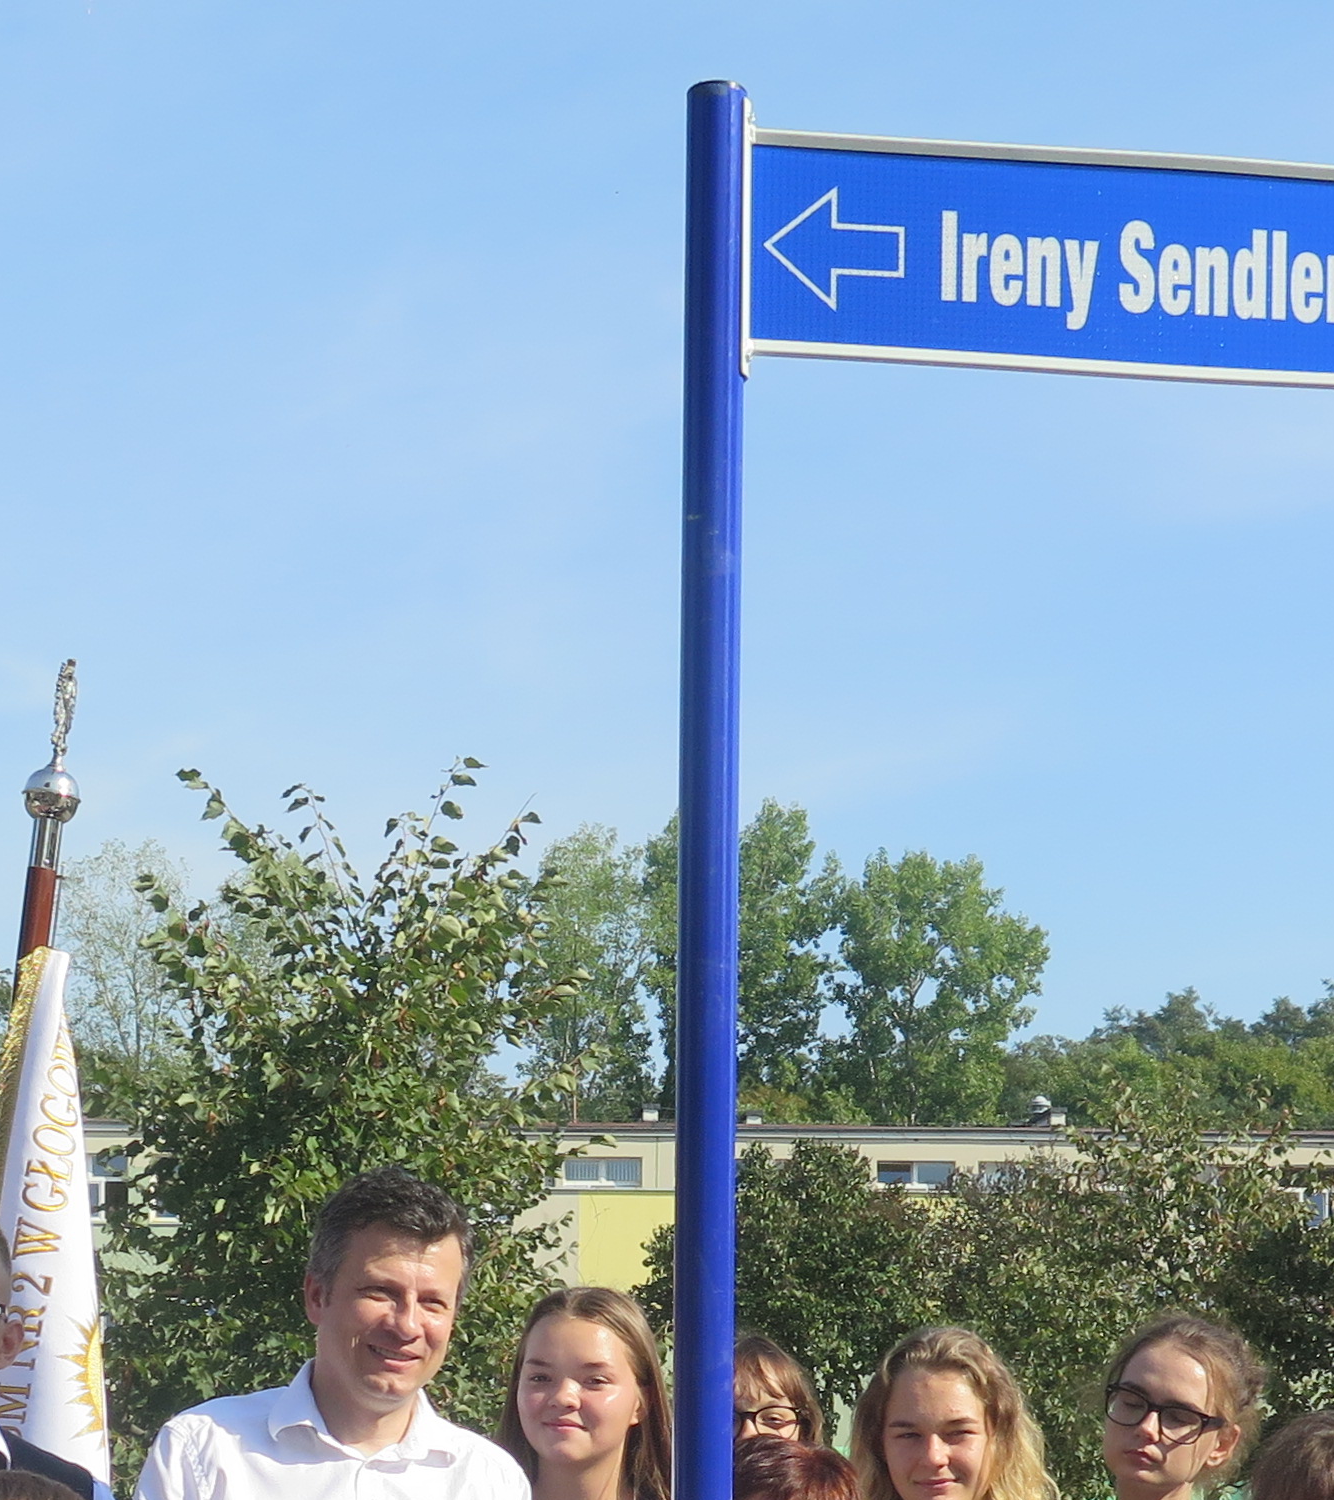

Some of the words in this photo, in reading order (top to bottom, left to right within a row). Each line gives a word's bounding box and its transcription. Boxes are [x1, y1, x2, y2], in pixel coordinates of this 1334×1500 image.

[941, 209, 1100, 331] Ireny
[11, 1215, 62, 1261] W
[12, 1271, 54, 1297] 2
